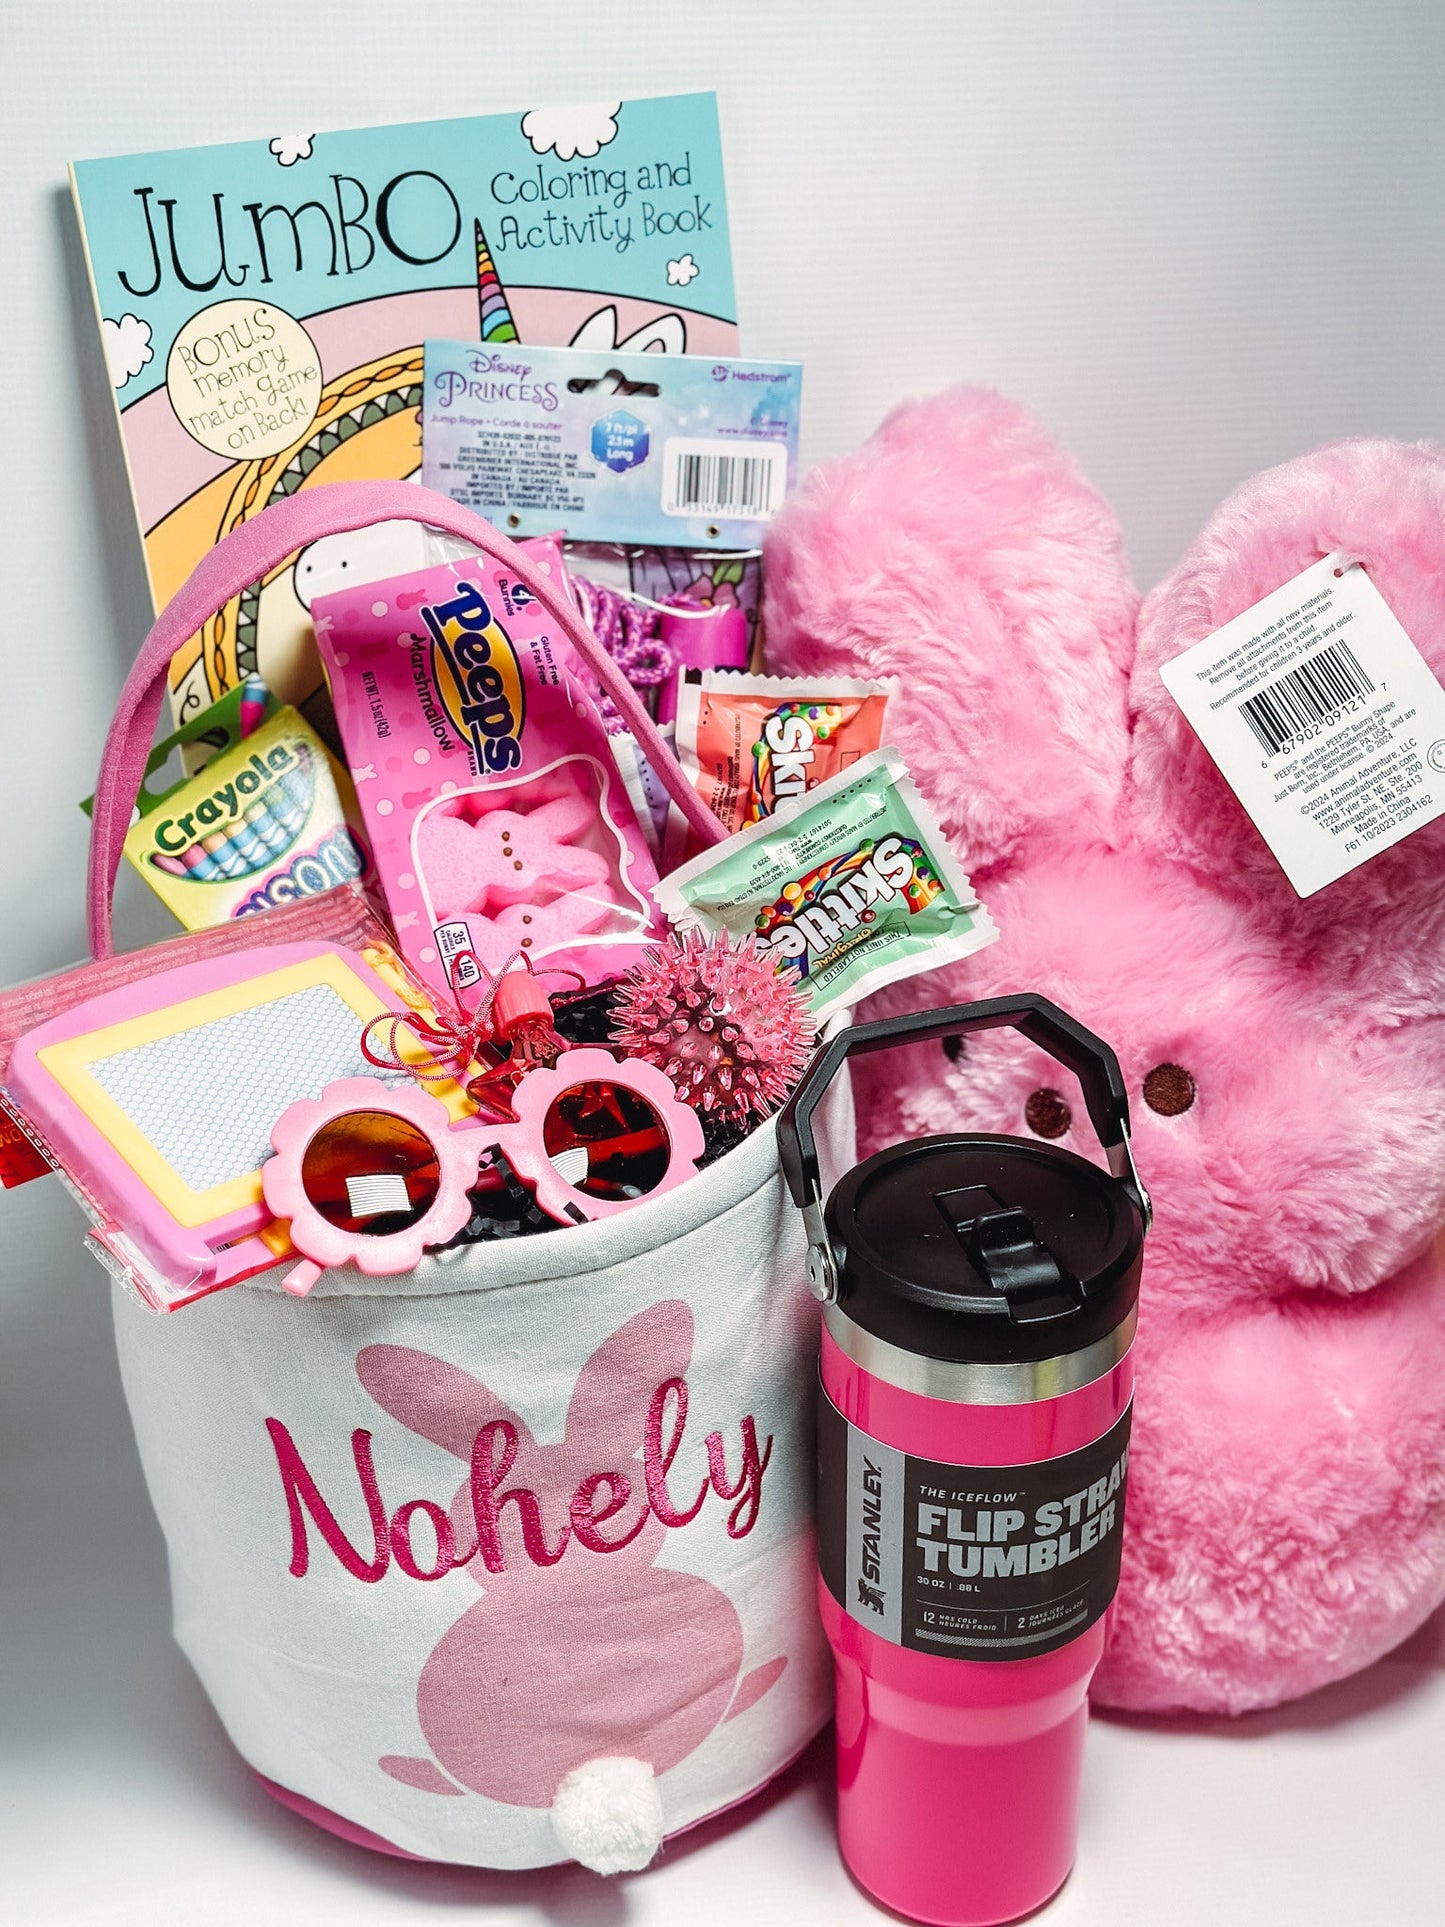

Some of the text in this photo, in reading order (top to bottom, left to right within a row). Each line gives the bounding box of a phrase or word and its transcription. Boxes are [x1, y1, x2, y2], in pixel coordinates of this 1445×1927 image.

[490, 152, 692, 208] Coloring and
[495, 195, 714, 253] Activity Book
[193, 343, 287, 399] memory
[187, 364, 318, 437] match game
[227, 399, 309, 452] on Back!
[431, 414, 457, 426] Jump
[459, 416, 484, 427] Rope
[492, 417, 521, 428] Corde
[532, 421, 563, 431] sauter
[498, 578, 514, 616] Bunnies
[539, 635, 561, 685] Gluten Free
[1196, 588, 1334, 680] This item was made with all new materials.
[1208, 600, 1332, 685] Remove all attachments from this item
[1209, 613, 1356, 710] Recommended for children 3 years and older.
[1235, 663, 1257, 680] before
[1258, 650, 1279, 667] giving
[1298, 624, 1317, 639] child.
[434, 582, 523, 773] Peeps
[529, 640, 549, 685] & Fat Free
[409, 633, 455, 752] Marshmallow
[1261, 682, 1386, 768] 6 67902 09121 7
[1293, 716, 1385, 779] are registered trademarks of
[1300, 752, 1314, 764] and
[1313, 745, 1326, 755] the
[1350, 715, 1373, 732] Bunny
[1372, 701, 1395, 718] Shape
[467, 750, 477, 776] BRAND
[1274, 788, 1288, 802] Just
[1287, 779, 1307, 792] Born,
[1305, 766, 1323, 780] Inc.,
[1321, 745, 1360, 771] Bethlehem,
[1389, 715, 1404, 728] and
[1403, 708, 1416, 719] are
[1300, 737, 1416, 814] ©2024 Animal Adventure, LLC
[1302, 779, 1319, 793] used
[1319, 767, 1339, 782] under
[1338, 752, 1366, 770] license.
[155, 744, 295, 851] Crayola
[1312, 752, 1416, 820] www.animaladventure.com
[1318, 812, 1340, 829] 1229
[1339, 800, 1360, 815] Tyler
[1387, 774, 1405, 786] Ste.
[1405, 760, 1422, 776] 200
[1330, 774, 1422, 835] Minneapolis, MN 55413
[1344, 794, 1433, 852] F61 10/2023 2304162
[1353, 796, 1411, 833] Made in China
[452, 930, 465, 944] 35
[460, 958, 475, 978] 140
[818, 955, 854, 983] LABELED
[849, 945, 866, 959] NOT
[865, 937, 884, 952] UNIT
[265, 1376, 774, 1583] Nohely
[919, 1485, 946, 1500] THE
[915, 1500, 1116, 1579] TUMBLER
[916, 1502, 1025, 1543] FLIP
[917, 1576, 930, 1586] 30
[931, 1579, 945, 1589] OZ
[974, 1585, 981, 1593] L
[923, 1611, 936, 1625] 12
[957, 1616, 978, 1625] COLD
[1017, 1617, 1026, 1629] 2
[938, 1620, 970, 1630] HEURES
[972, 1623, 997, 1632] FROID
